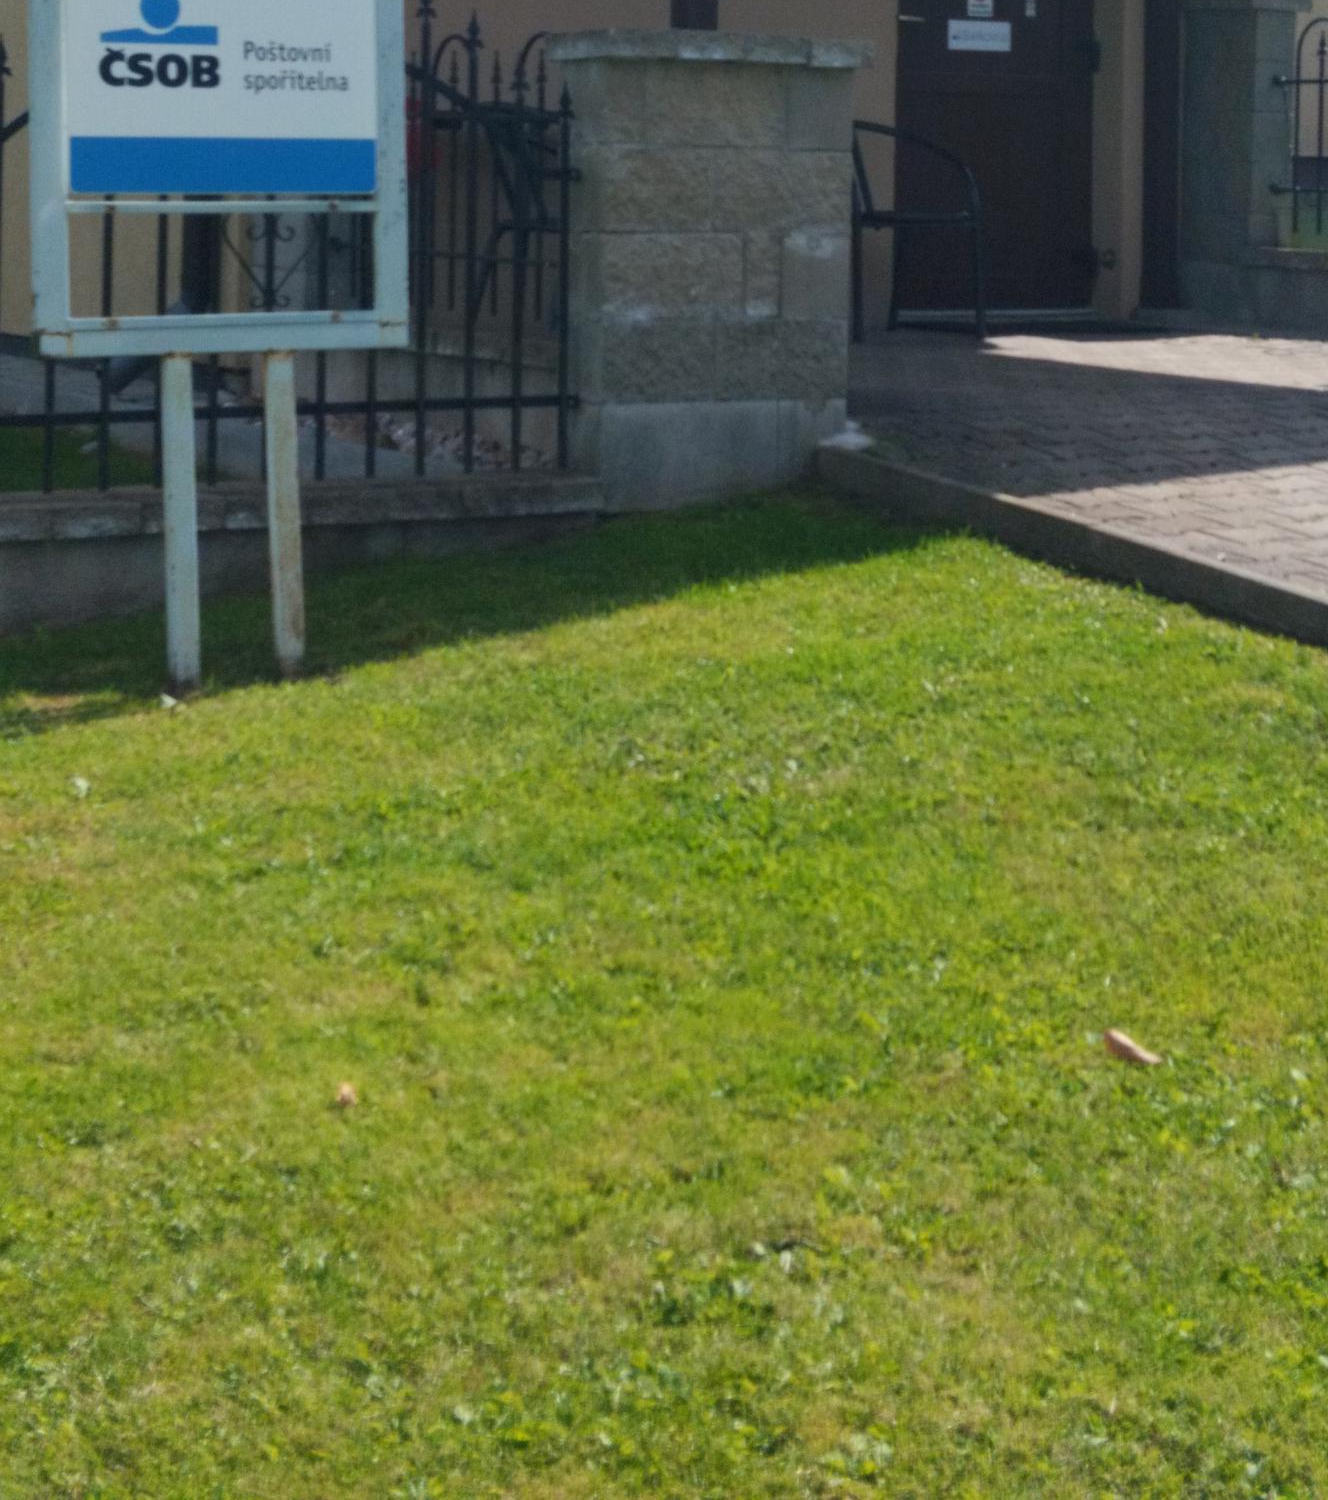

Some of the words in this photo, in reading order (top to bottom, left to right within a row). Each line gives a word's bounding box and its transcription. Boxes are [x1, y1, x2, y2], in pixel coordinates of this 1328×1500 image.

[243, 40, 331, 63] Poštovní
[99, 48, 220, 88] ČSOB
[243, 72, 349, 93] spořitelna
